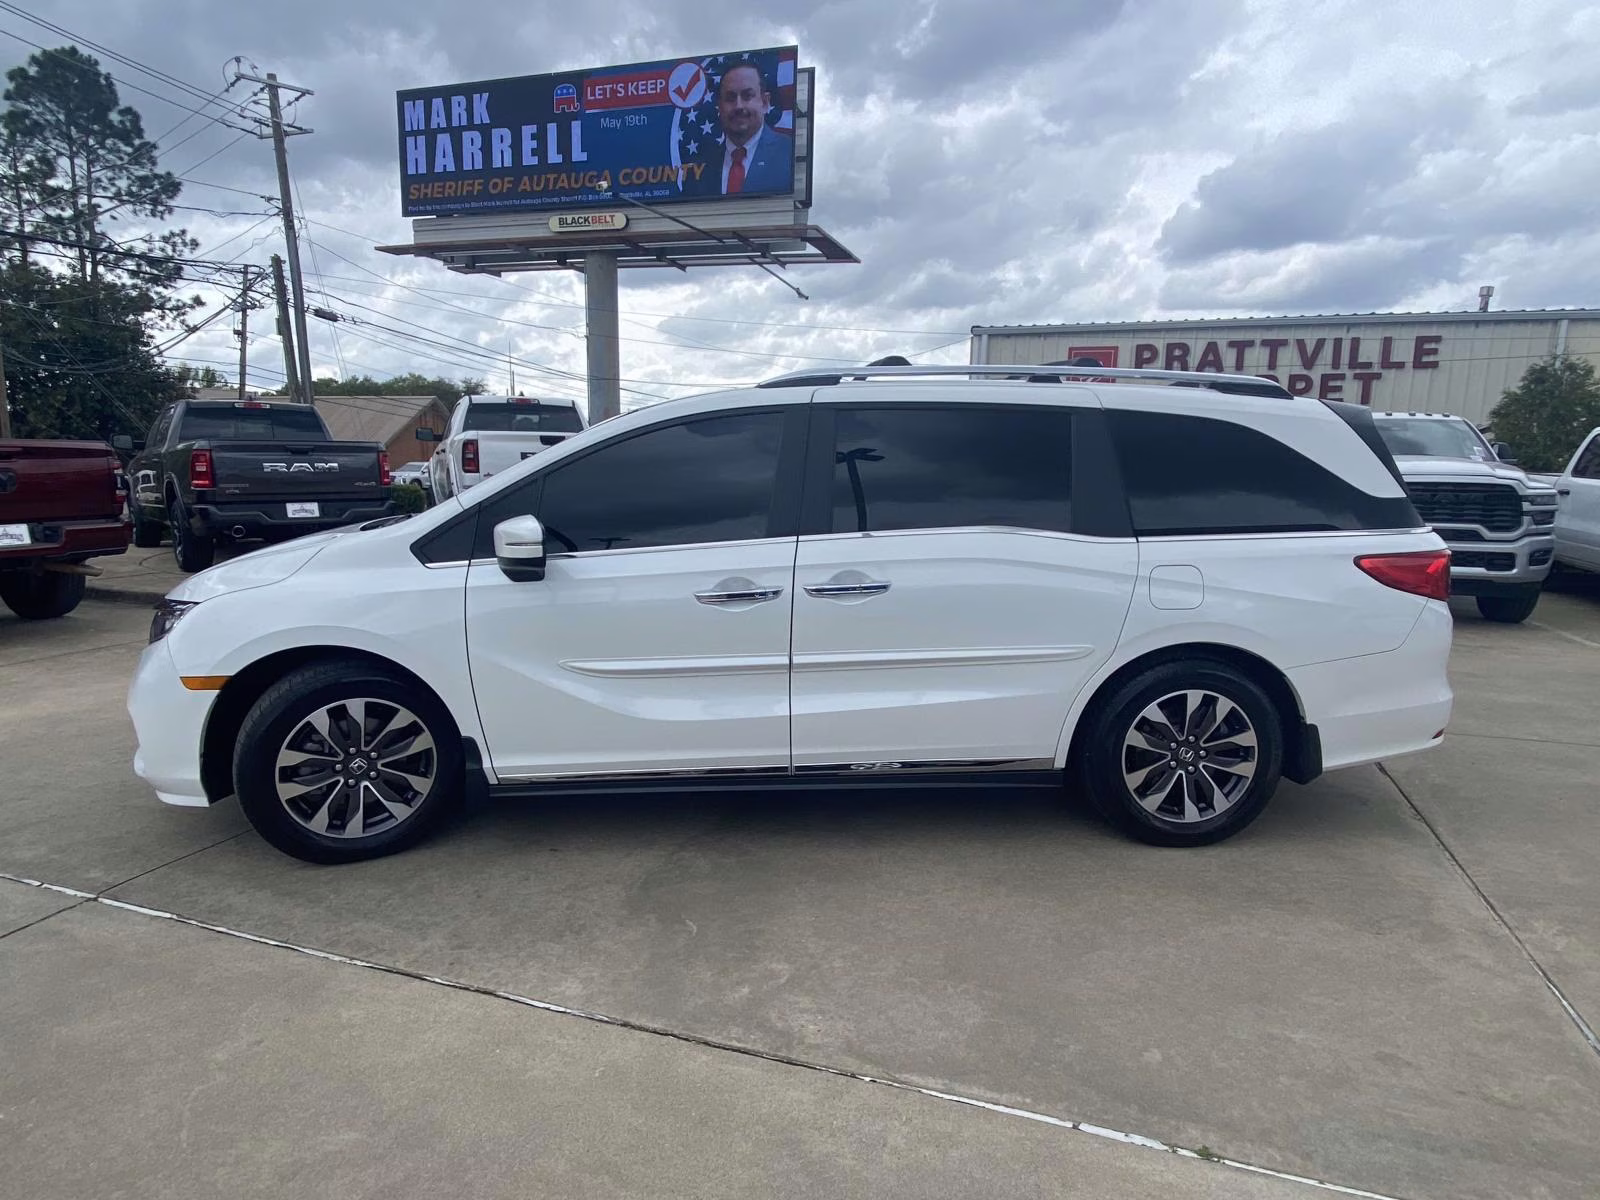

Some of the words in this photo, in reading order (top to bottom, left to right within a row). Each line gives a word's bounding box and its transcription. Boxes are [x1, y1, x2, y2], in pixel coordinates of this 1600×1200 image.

[587, 83, 625, 100] LET'S
[627, 79, 666, 97] KEEP
[403, 92, 491, 132] MARK
[600, 116, 622, 130] May
[624, 113, 648, 127] 19th
[405, 120, 588, 175] HARRELL
[408, 179, 484, 200] SHERIFF
[488, 177, 515, 195] OF
[518, 169, 613, 192] AUTAUGA
[619, 162, 707, 186] COUNTY
[558, 214, 616, 226] BLACKBELT
[1134, 334, 1443, 373] PRATTVILLE
[262, 462, 340, 473] RAM
